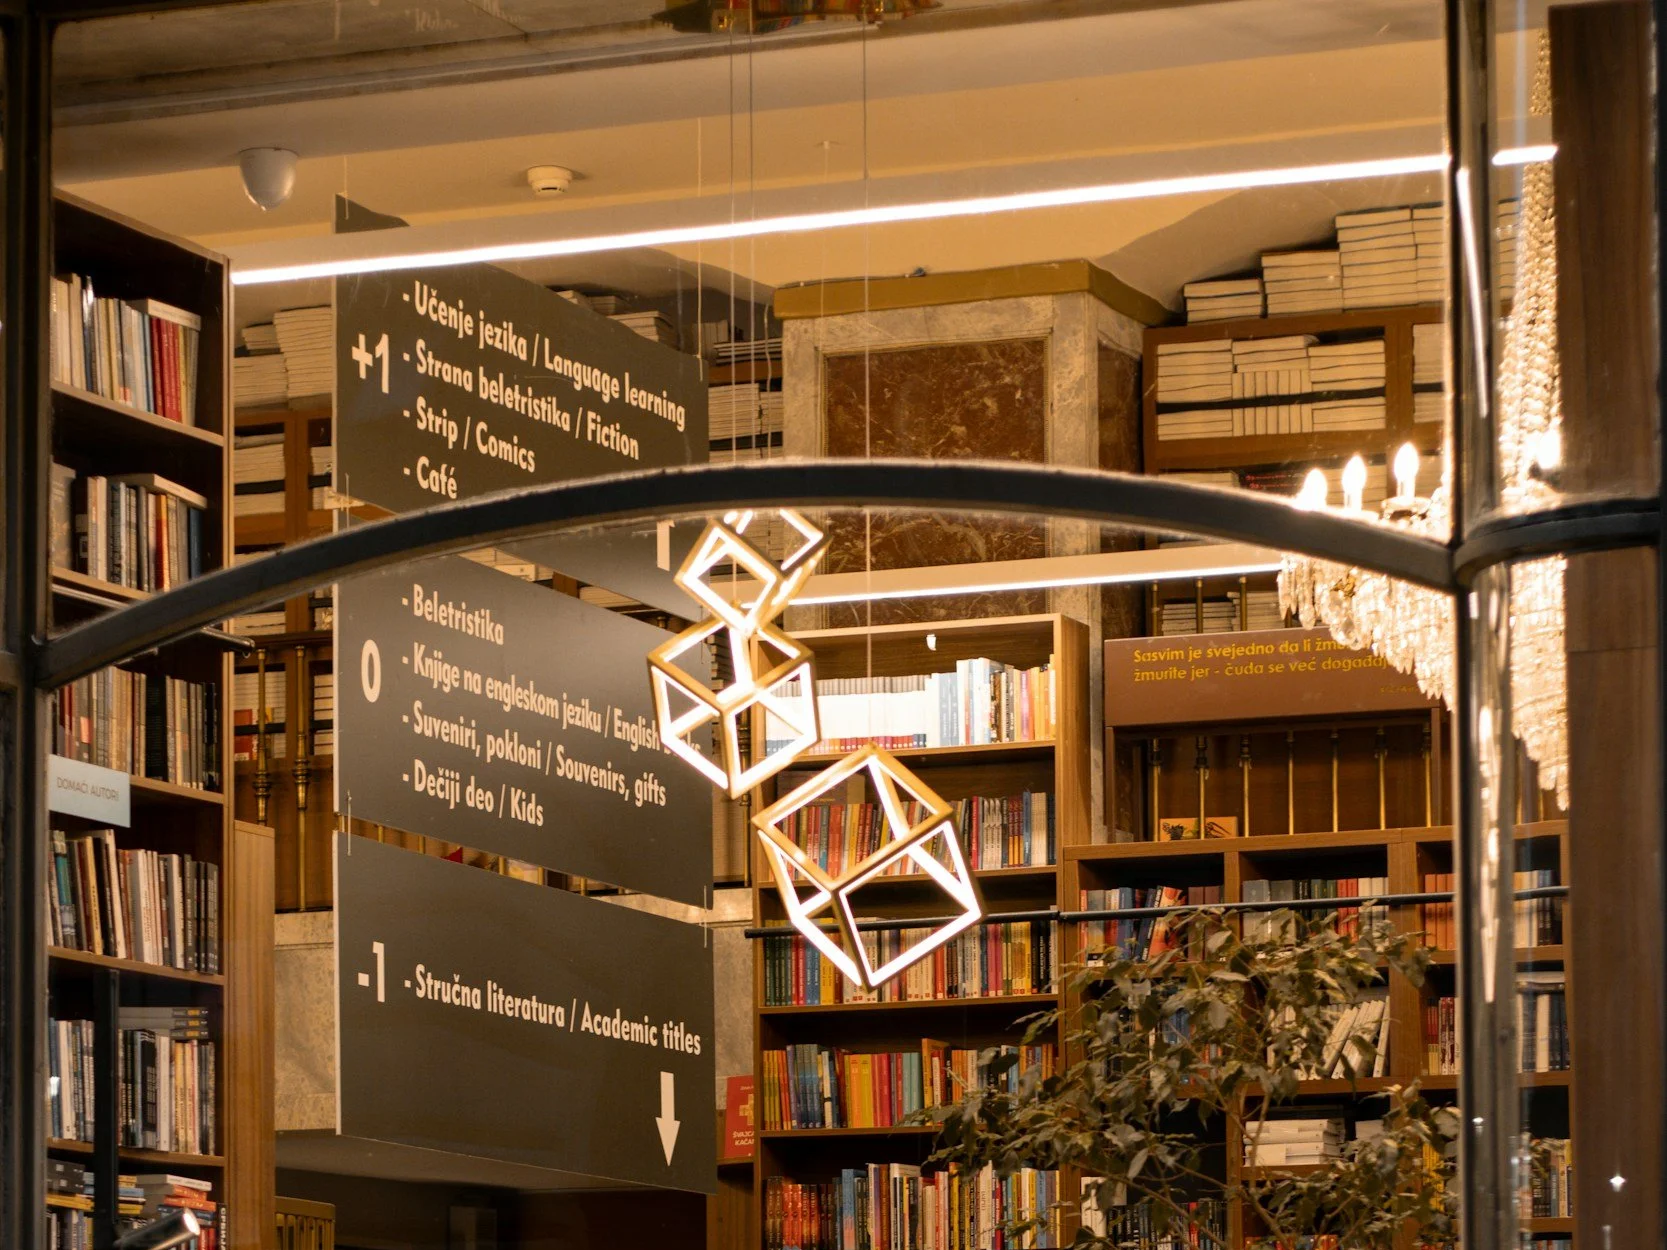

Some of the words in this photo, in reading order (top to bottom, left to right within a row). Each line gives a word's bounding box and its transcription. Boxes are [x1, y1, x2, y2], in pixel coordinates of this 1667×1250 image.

[352, 333, 389, 394] +1
[415, 281, 473, 338] Učenje
[479, 310, 527, 362] jezika
[544, 339, 620, 402] Language
[624, 372, 685, 432] learning
[416, 340, 473, 392] Strana
[479, 366, 571, 432] beletristika
[587, 410, 639, 460] Fiction
[416, 397, 459, 450] Strip
[475, 421, 535, 473] Comics
[416, 456, 458, 499] Café
[413, 583, 504, 646] Beletristika
[361, 639, 382, 703] 0
[1134, 646, 1185, 663] Sasvim
[1188, 647, 1202, 662] je
[1206, 642, 1275, 661] svejedno
[1279, 639, 1299, 654] da
[1303, 638, 1311, 653] li
[1315, 636, 1346, 651] žmu
[1134, 666, 1187, 682] žmurite
[1191, 665, 1210, 682] jer
[1224, 661, 1263, 677] čuda
[1268, 664, 1285, 674] se
[1289, 656, 1316, 672] već
[413, 642, 460, 693] Knjige
[463, 672, 482, 695] na
[486, 674, 559, 718] engleskom
[563, 692, 602, 733] jeziku
[614, 708, 660, 754] English
[413, 700, 481, 758] Suveniri,
[486, 730, 541, 770] pokloni
[556, 744, 630, 801] Souvenirs,
[634, 773, 667, 807] gifts
[91, 784, 120, 802] AUTORI
[414, 759, 460, 810] Dečiji
[465, 784, 494, 813] deo
[511, 787, 544, 827] Kids
[358, 941, 385, 1002] -1
[415, 963, 481, 1010] Stručna
[487, 980, 565, 1028] literatura
[580, 1001, 658, 1047] Academic
[662, 1020, 701, 1056] titles
